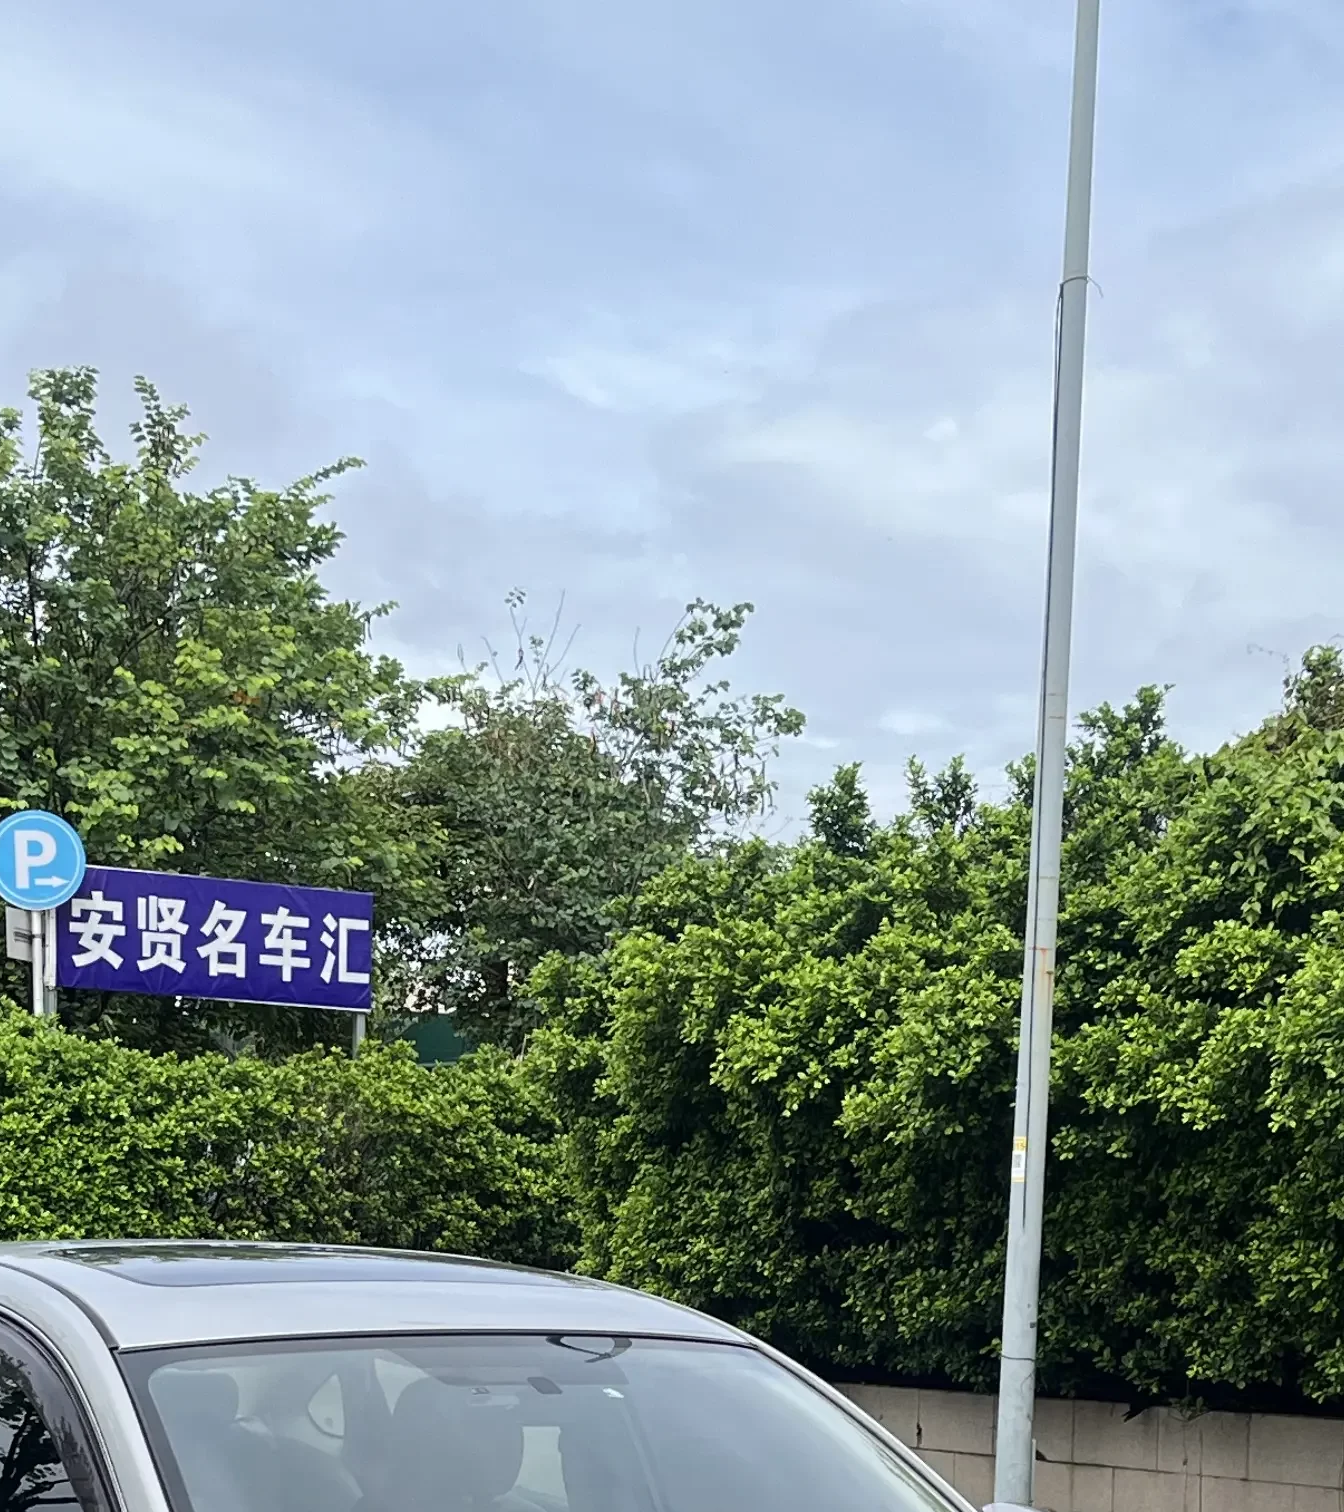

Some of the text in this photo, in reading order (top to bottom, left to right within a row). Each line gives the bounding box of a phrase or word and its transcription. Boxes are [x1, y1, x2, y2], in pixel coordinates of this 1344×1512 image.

[13, 830, 57, 889] P
[69, 891, 370, 985] 安贤名车汇
